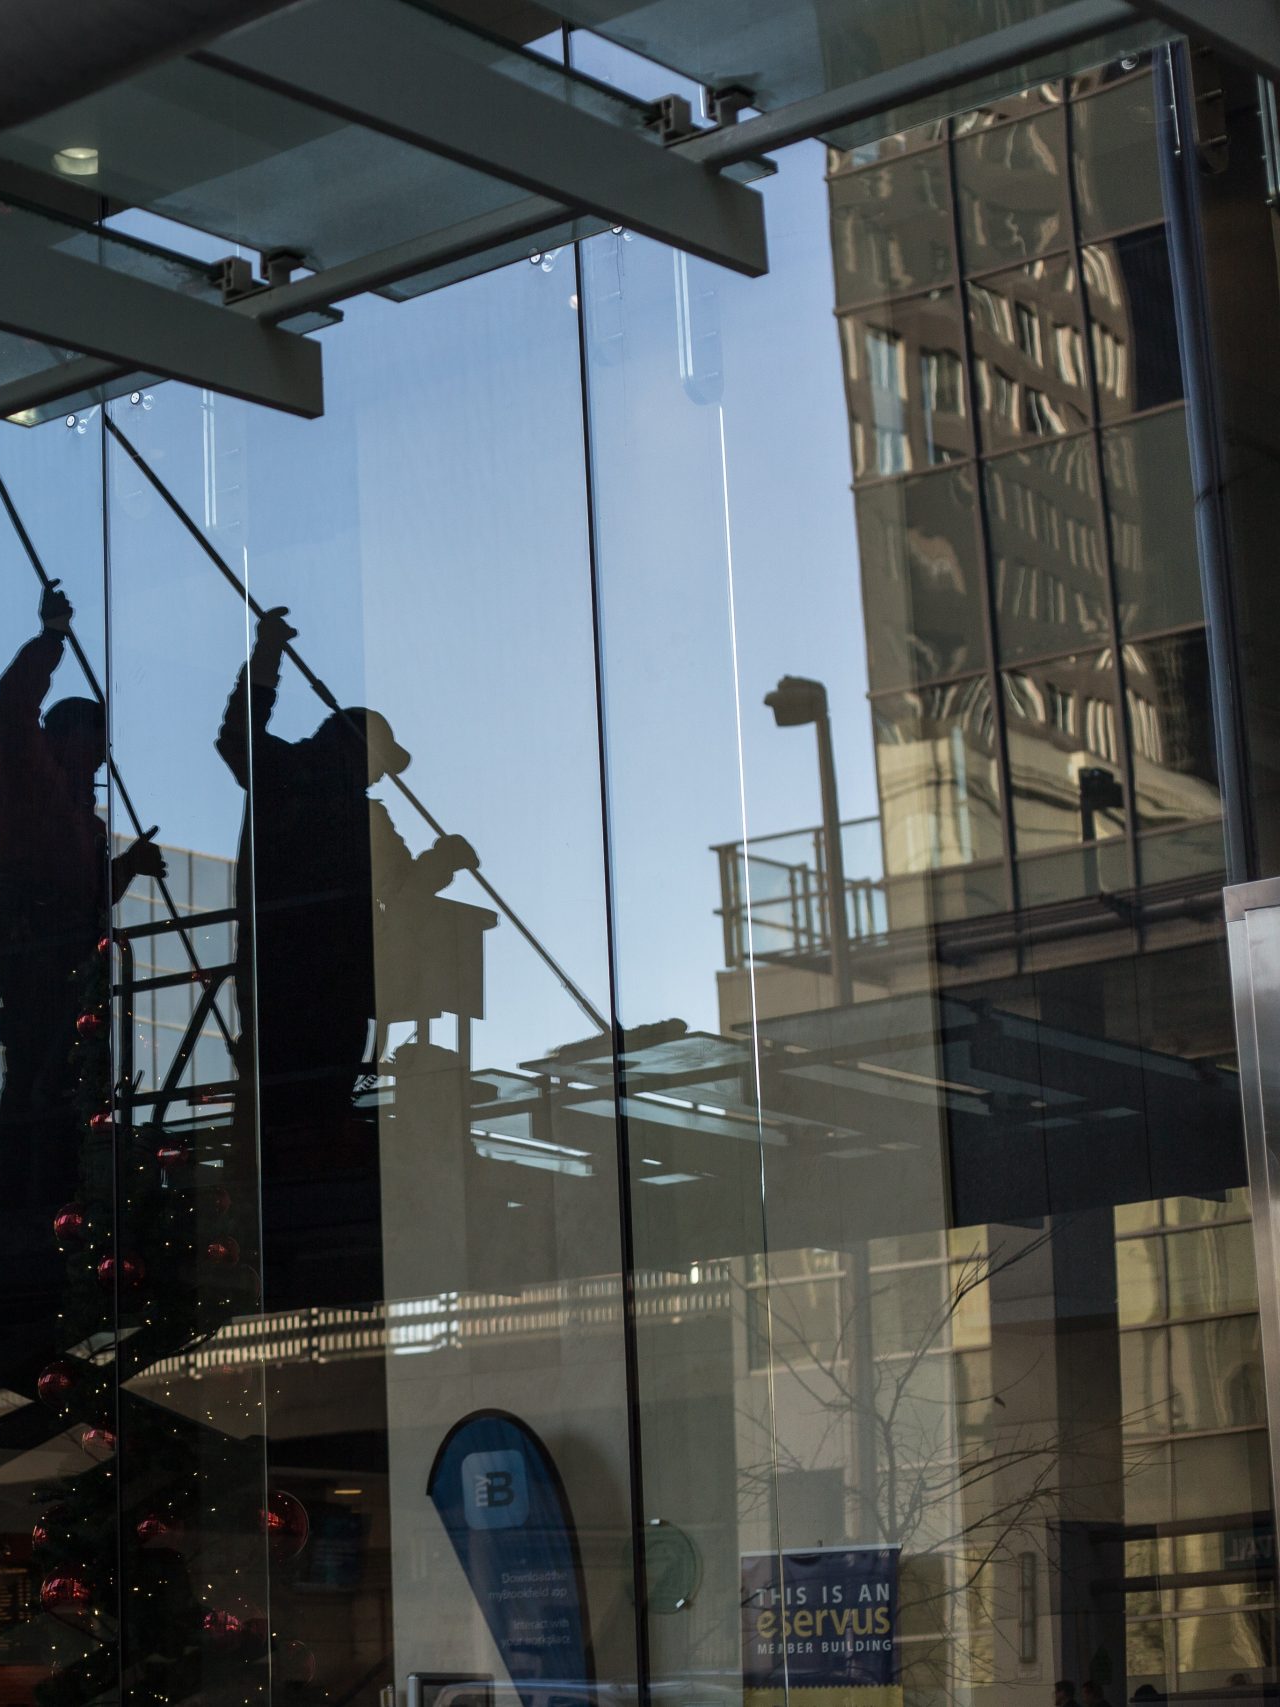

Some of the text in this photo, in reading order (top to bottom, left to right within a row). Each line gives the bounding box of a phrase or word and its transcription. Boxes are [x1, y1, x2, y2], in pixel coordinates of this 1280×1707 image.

[486, 1472, 514, 1507] B
[756, 1583, 890, 1606] THIS IS AN
[821, 1639, 892, 1653] BUILDING
